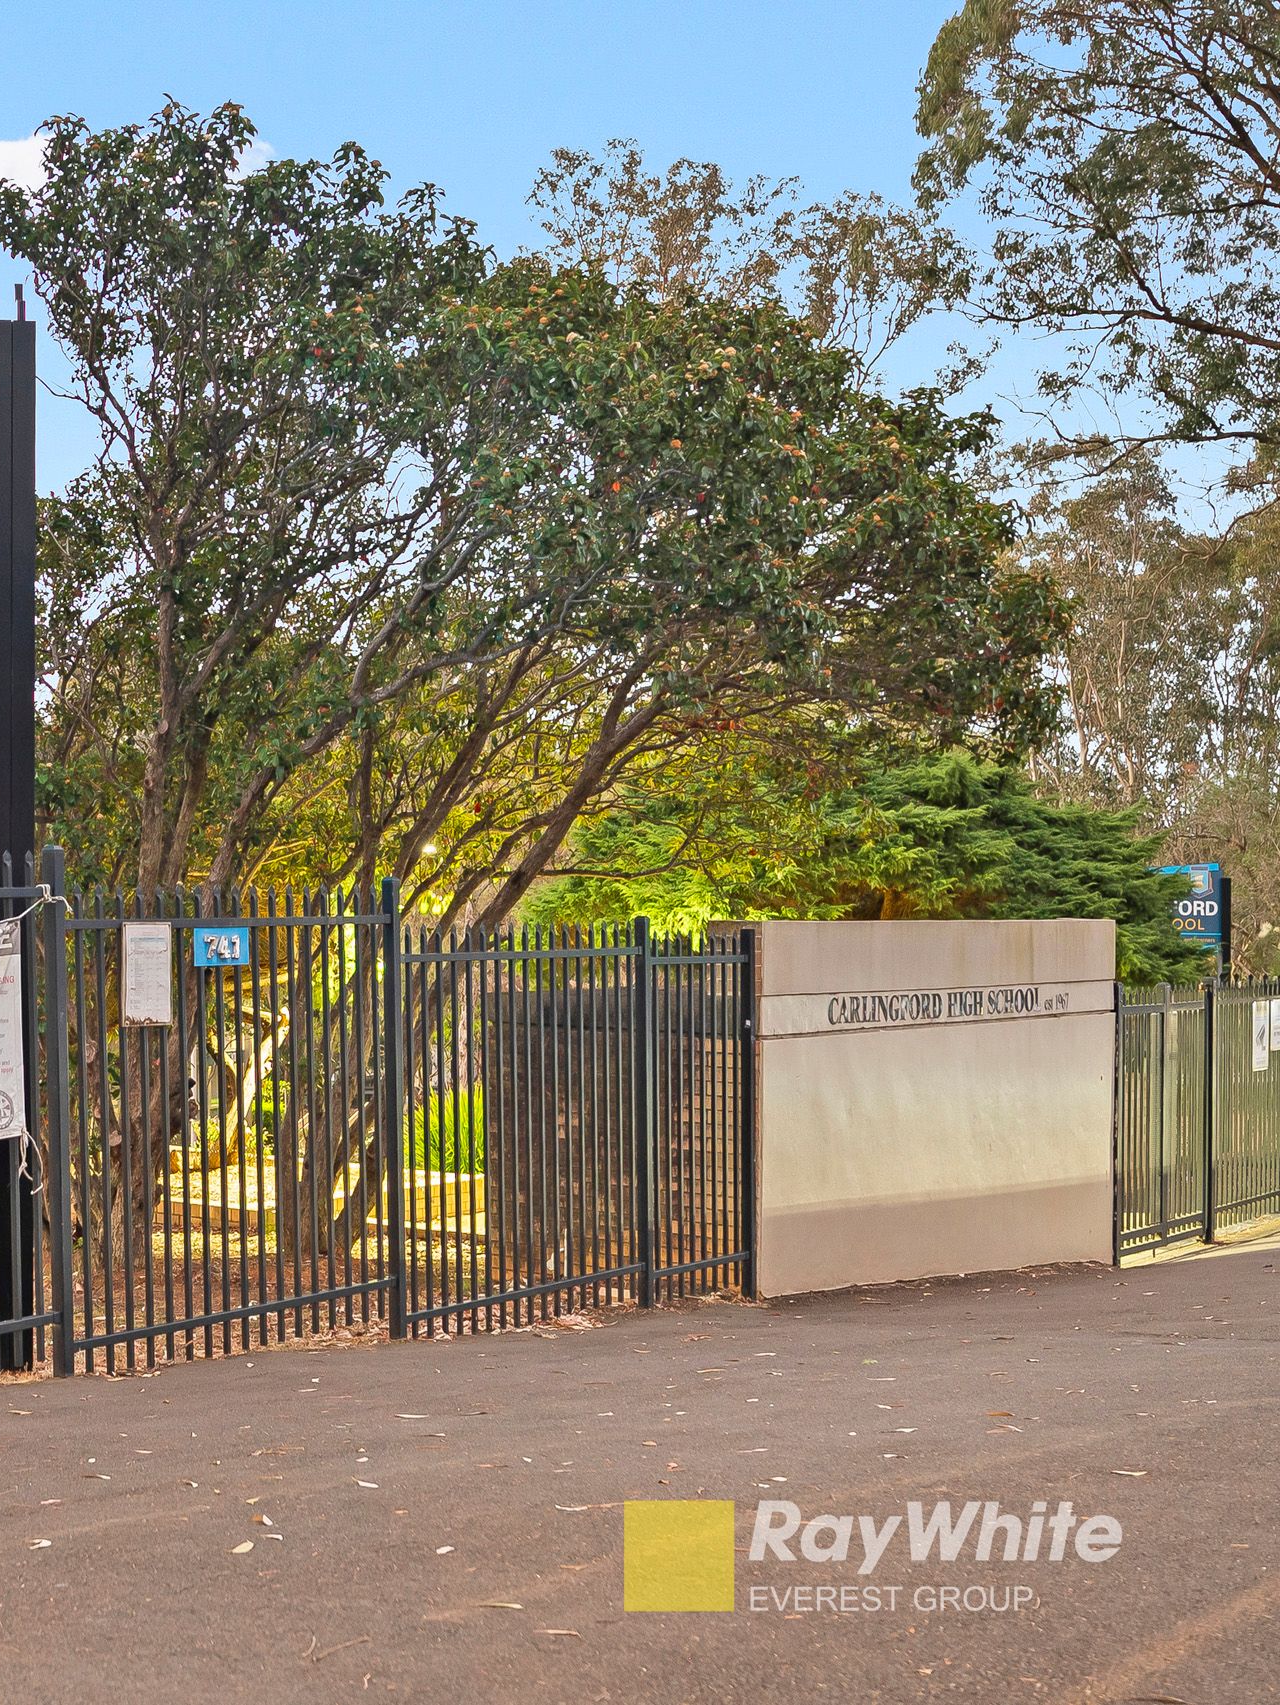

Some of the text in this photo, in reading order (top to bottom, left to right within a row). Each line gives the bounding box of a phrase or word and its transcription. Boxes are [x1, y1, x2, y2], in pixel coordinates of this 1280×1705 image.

[203, 934, 241, 960] 741
[827, 992, 943, 1026] CARLINGFORD
[946, 990, 985, 1018] HIGH
[987, 987, 1040, 1014] SCHOOL
